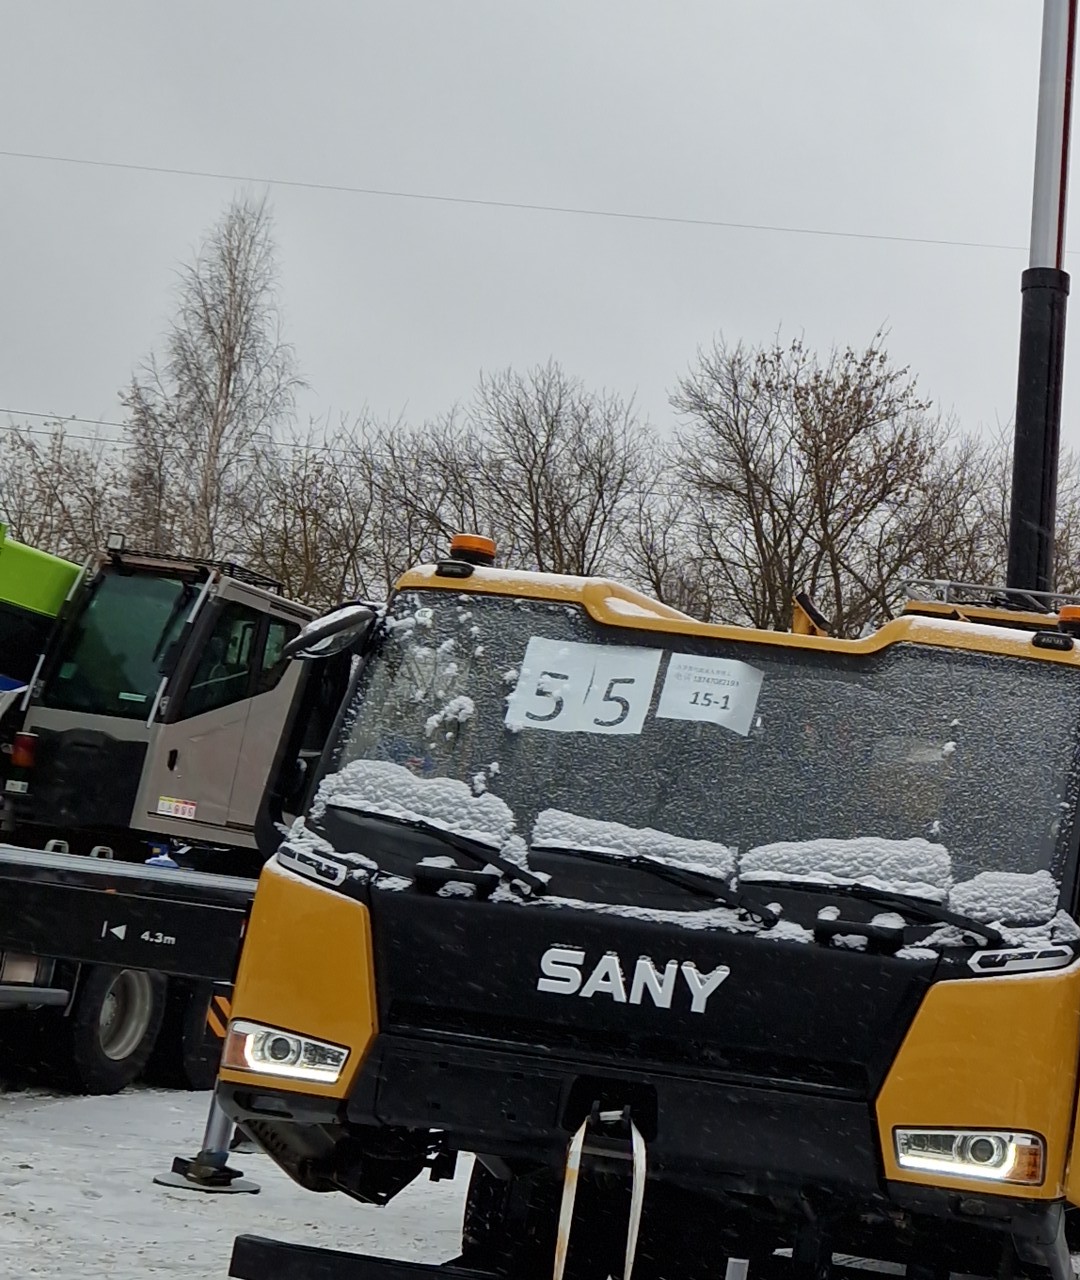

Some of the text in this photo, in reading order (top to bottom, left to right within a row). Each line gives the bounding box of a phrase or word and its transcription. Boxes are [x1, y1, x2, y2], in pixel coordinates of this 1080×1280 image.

[689, 691, 731, 711] 15-1
[140, 930, 176, 945] 4.3m
[537, 945, 731, 1014] SANY
